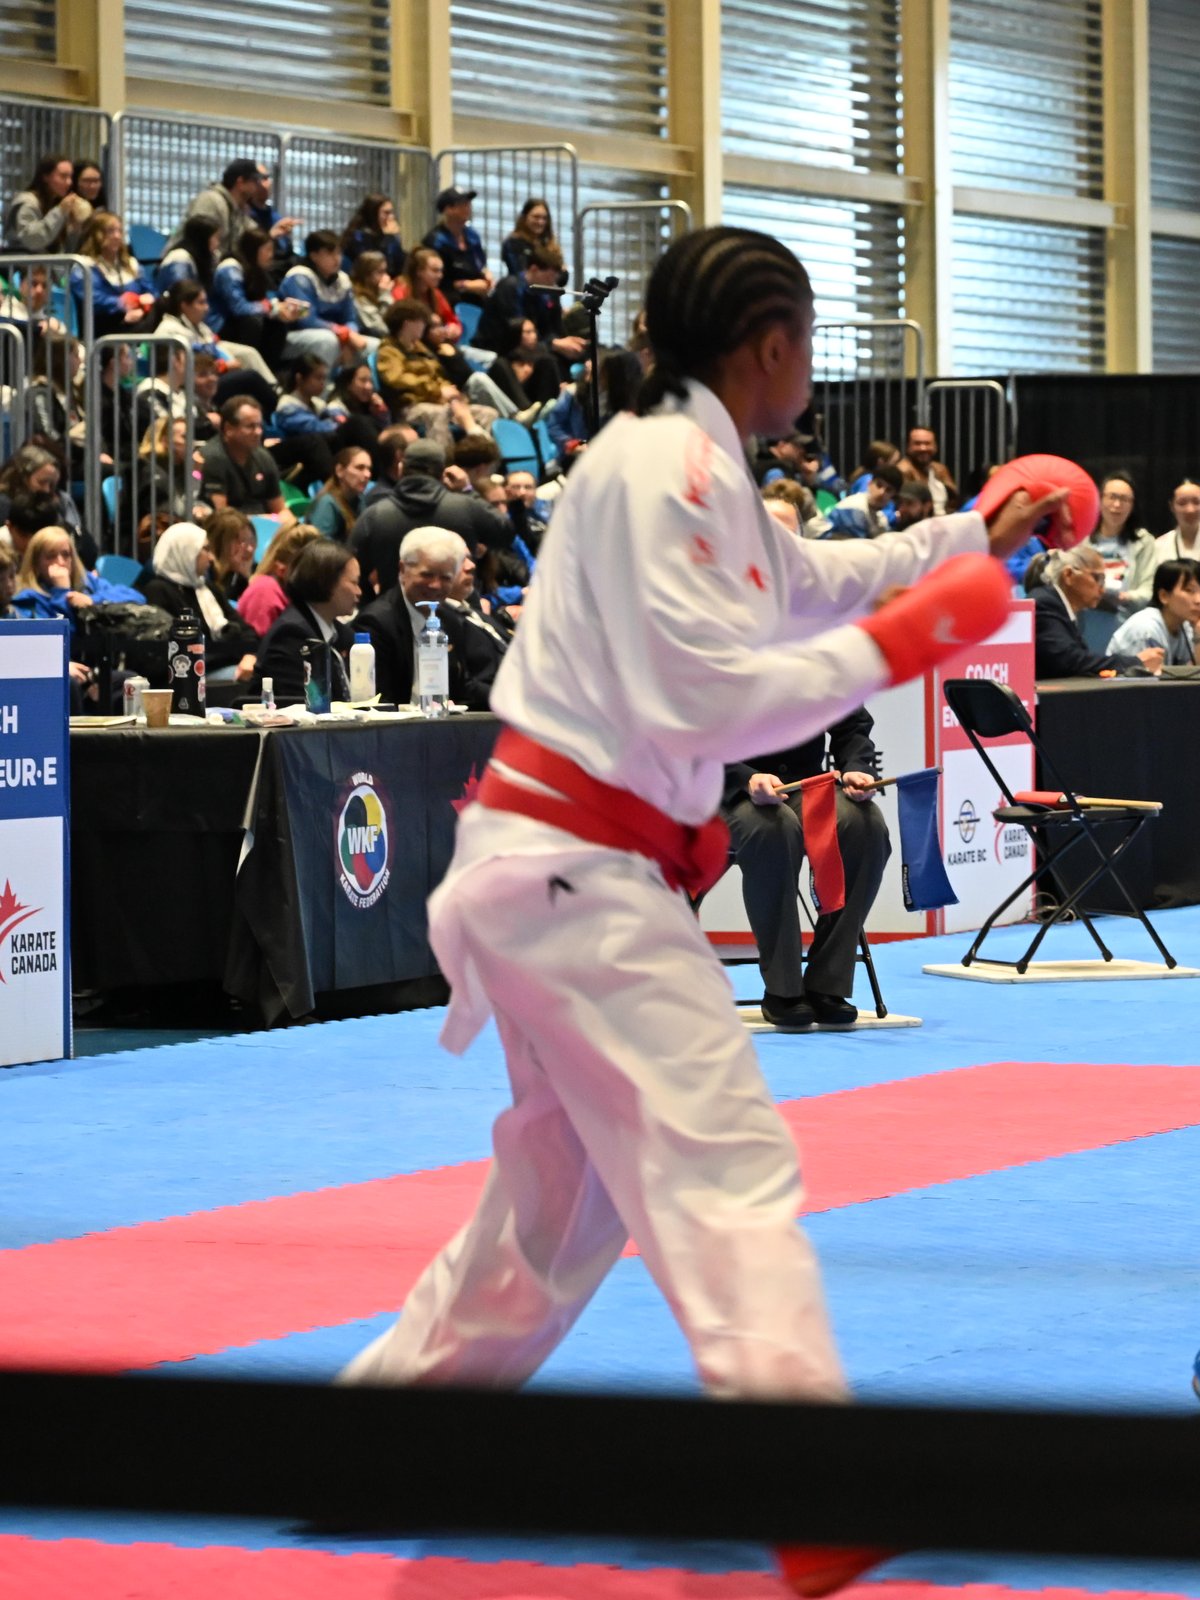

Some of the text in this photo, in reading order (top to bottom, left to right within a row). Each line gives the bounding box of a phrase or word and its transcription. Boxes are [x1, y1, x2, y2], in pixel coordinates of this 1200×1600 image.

[965, 663, 1009, 684] COACH
[0, 705, 18, 734] H
[351, 771, 374, 785] WORLD
[346, 824, 379, 855] WKF
[948, 848, 987, 866] KARATE BC
[340, 868, 391, 908] KARATE FEDERATION
[11, 931, 56, 953] KARATE
[11, 952, 57, 975] CANADA
